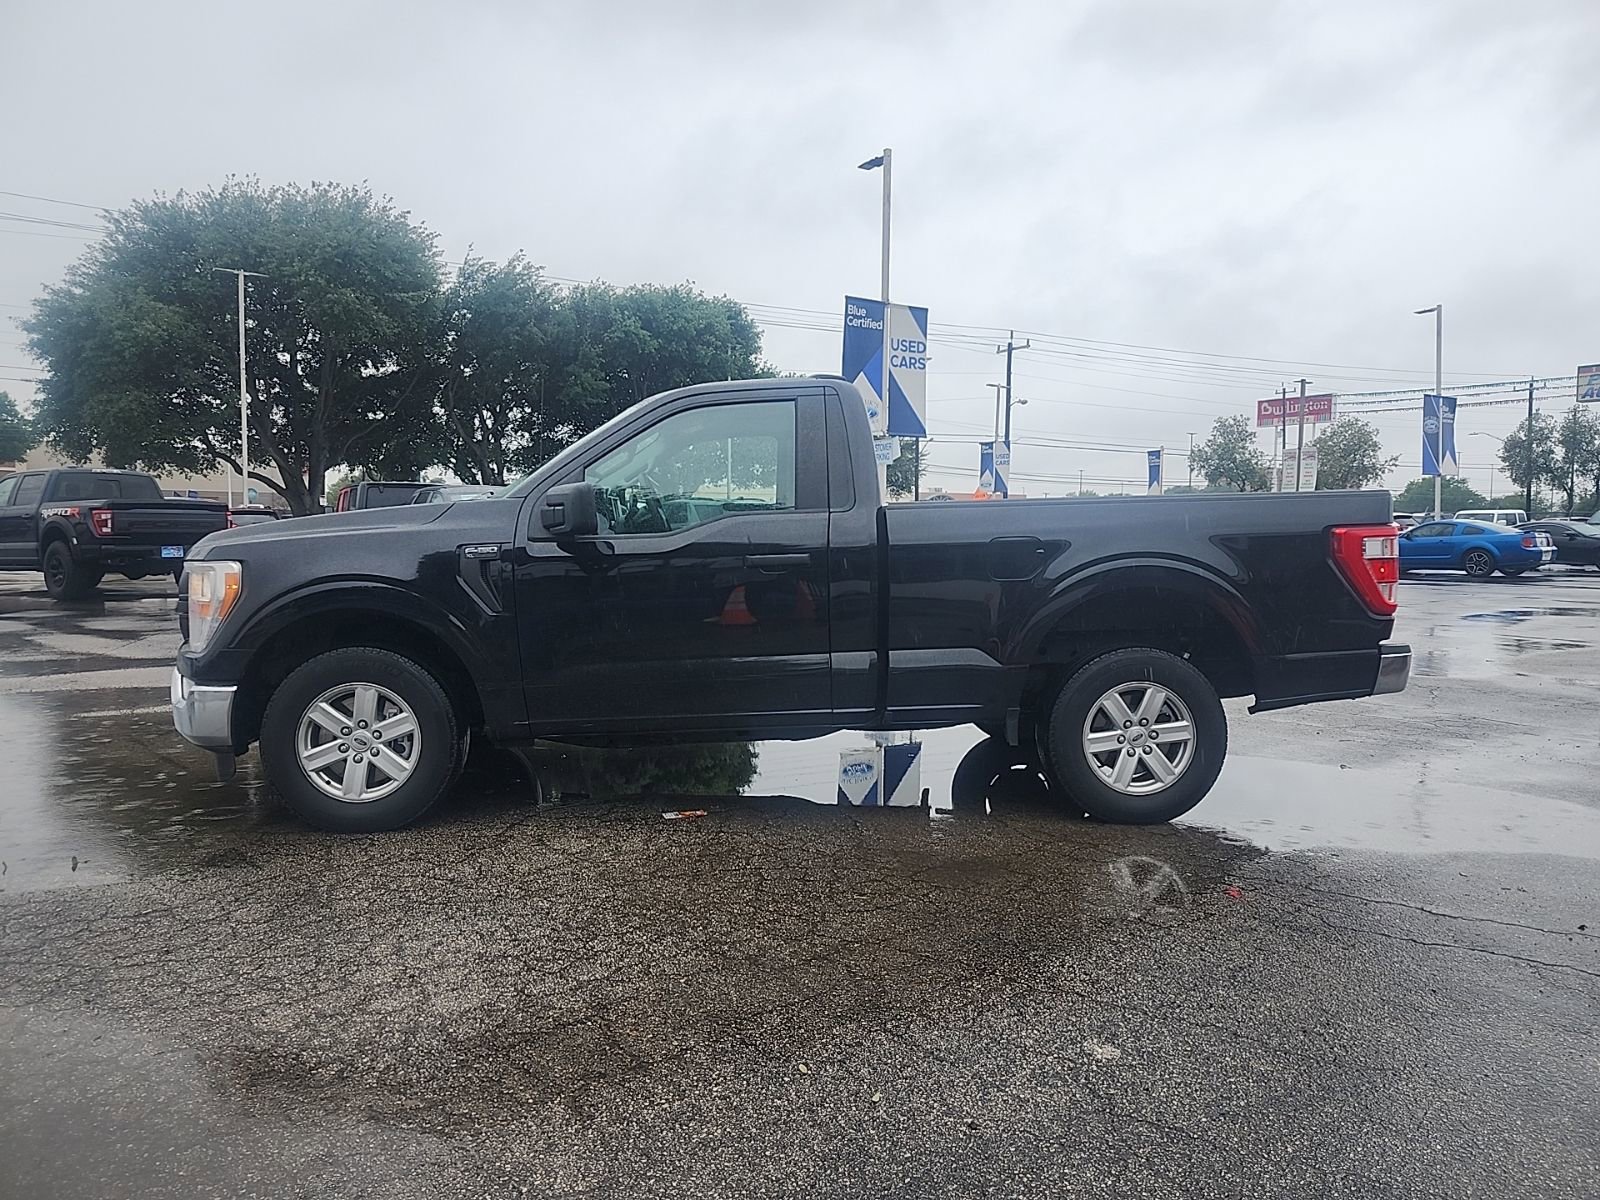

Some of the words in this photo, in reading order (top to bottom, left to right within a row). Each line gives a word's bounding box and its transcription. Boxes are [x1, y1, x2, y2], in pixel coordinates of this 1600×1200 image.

[848, 304, 867, 316] Blue
[847, 316, 883, 330] Certified
[891, 338, 926, 354] USED
[890, 354, 926, 370] CARS
[875, 443, 892, 452] STOMER
[41, 507, 80, 519] RAPTOR
